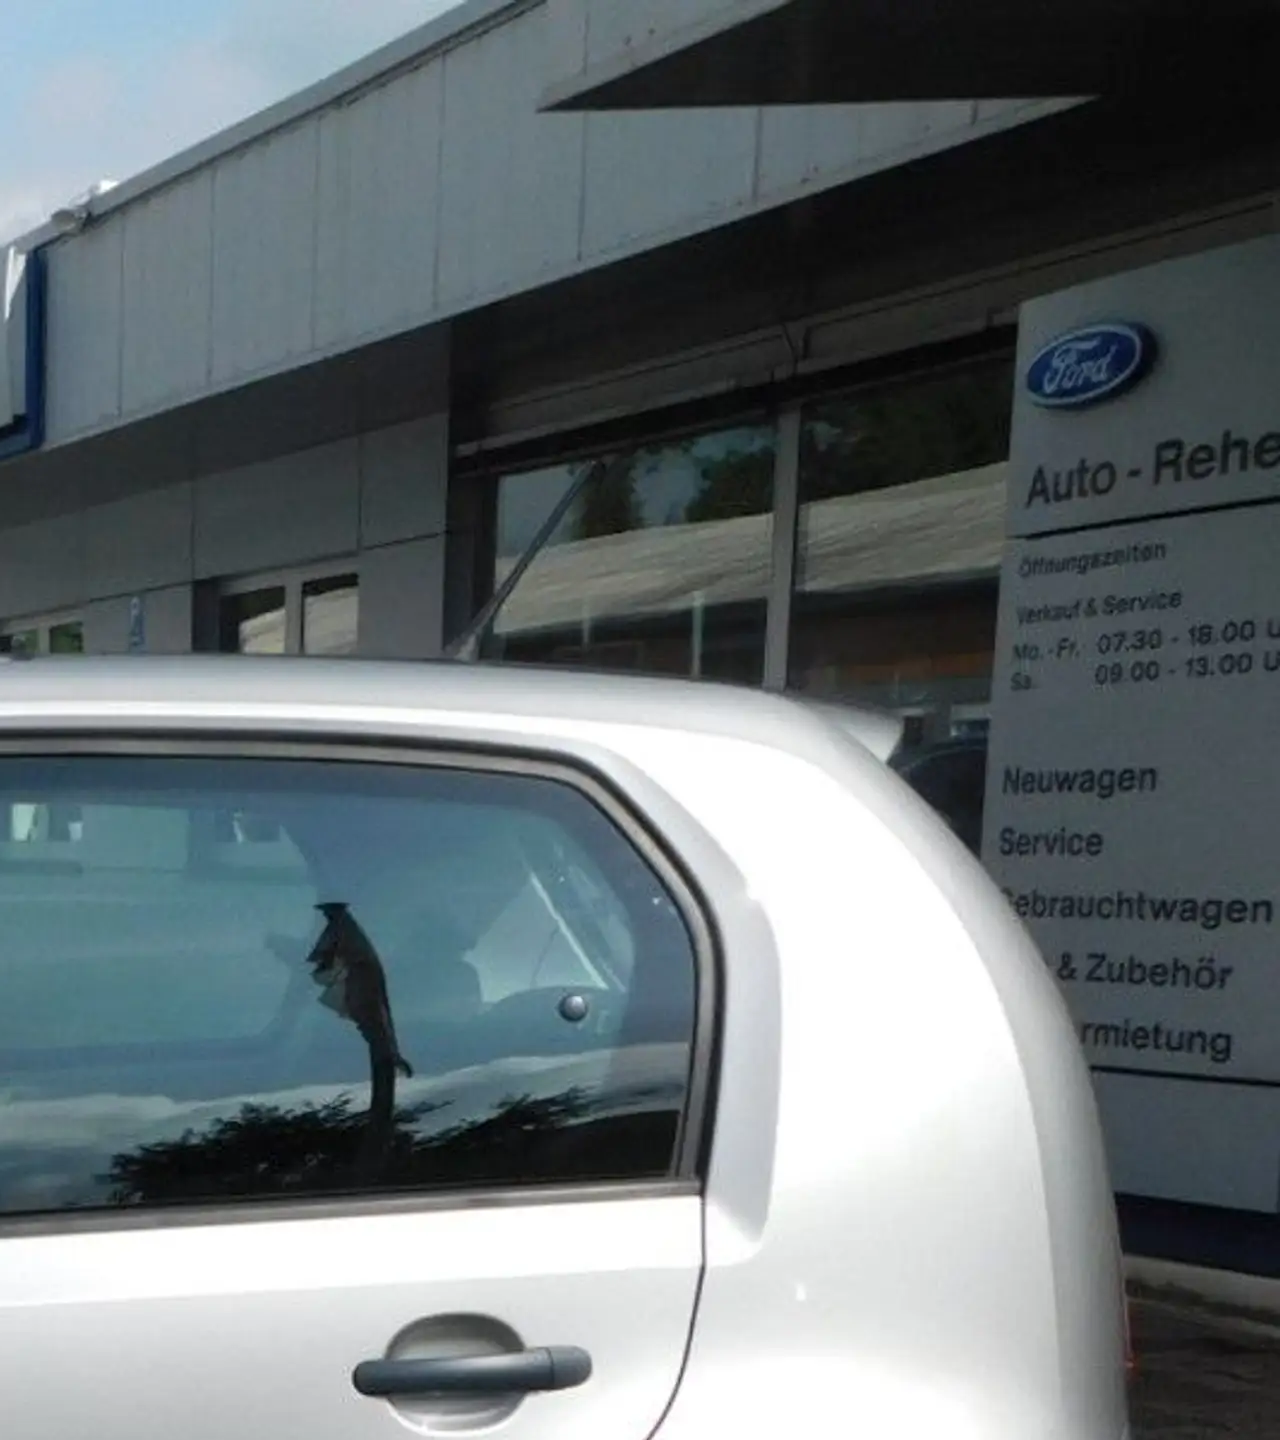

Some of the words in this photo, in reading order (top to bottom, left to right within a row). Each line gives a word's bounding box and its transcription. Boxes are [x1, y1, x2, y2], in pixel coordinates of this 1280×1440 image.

[1043, 336, 1118, 395] Ford
[1024, 457, 1118, 509] Auto
[1153, 428, 1280, 486] Rehe
[1102, 591, 1183, 616] Service
[1096, 628, 1163, 655] 07.30
[1184, 652, 1253, 679] 13.00
[1001, 765, 1159, 800] Neuwagen
[999, 826, 1104, 857] Service
[1056, 951, 1078, 981] &
[1085, 952, 1235, 991] Zubehör
